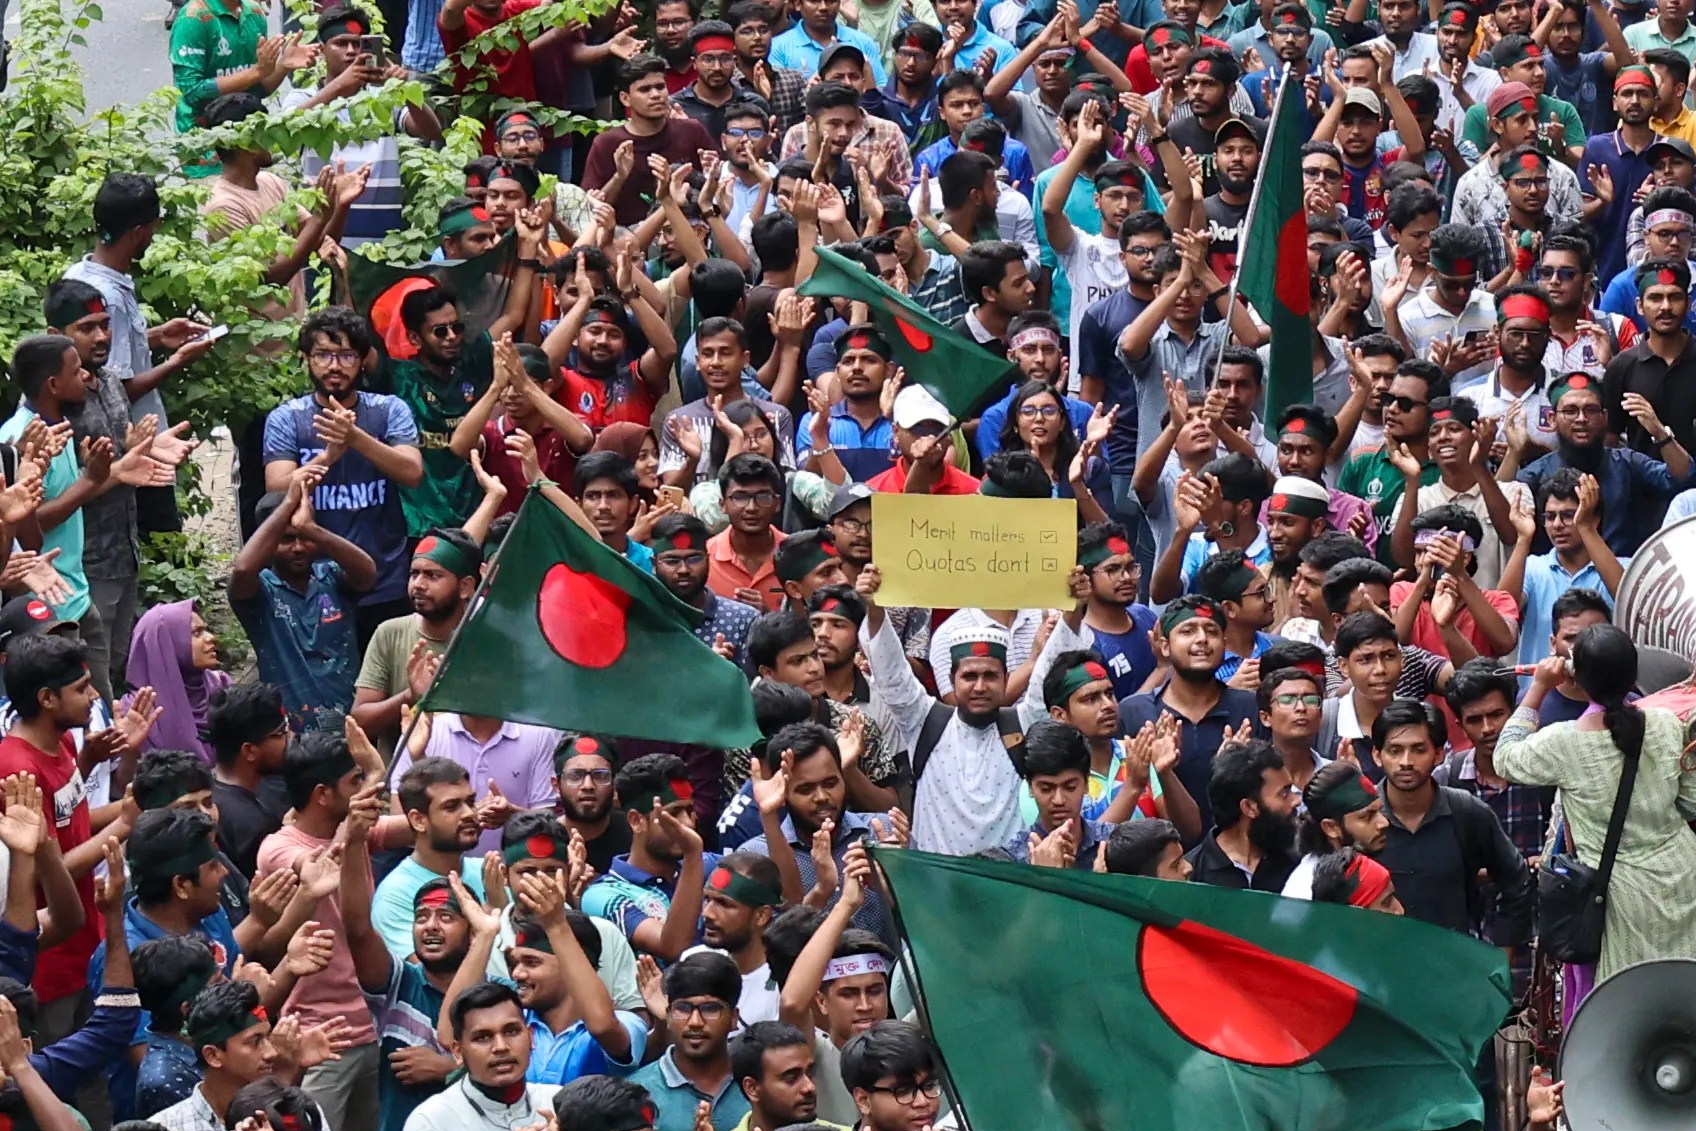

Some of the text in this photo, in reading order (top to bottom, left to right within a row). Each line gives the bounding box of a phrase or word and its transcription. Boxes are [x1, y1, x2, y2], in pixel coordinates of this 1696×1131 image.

[910, 517, 1026, 544] Merit matters
[905, 548, 978, 575] Quotas
[1107, 652, 1133, 678] 75
